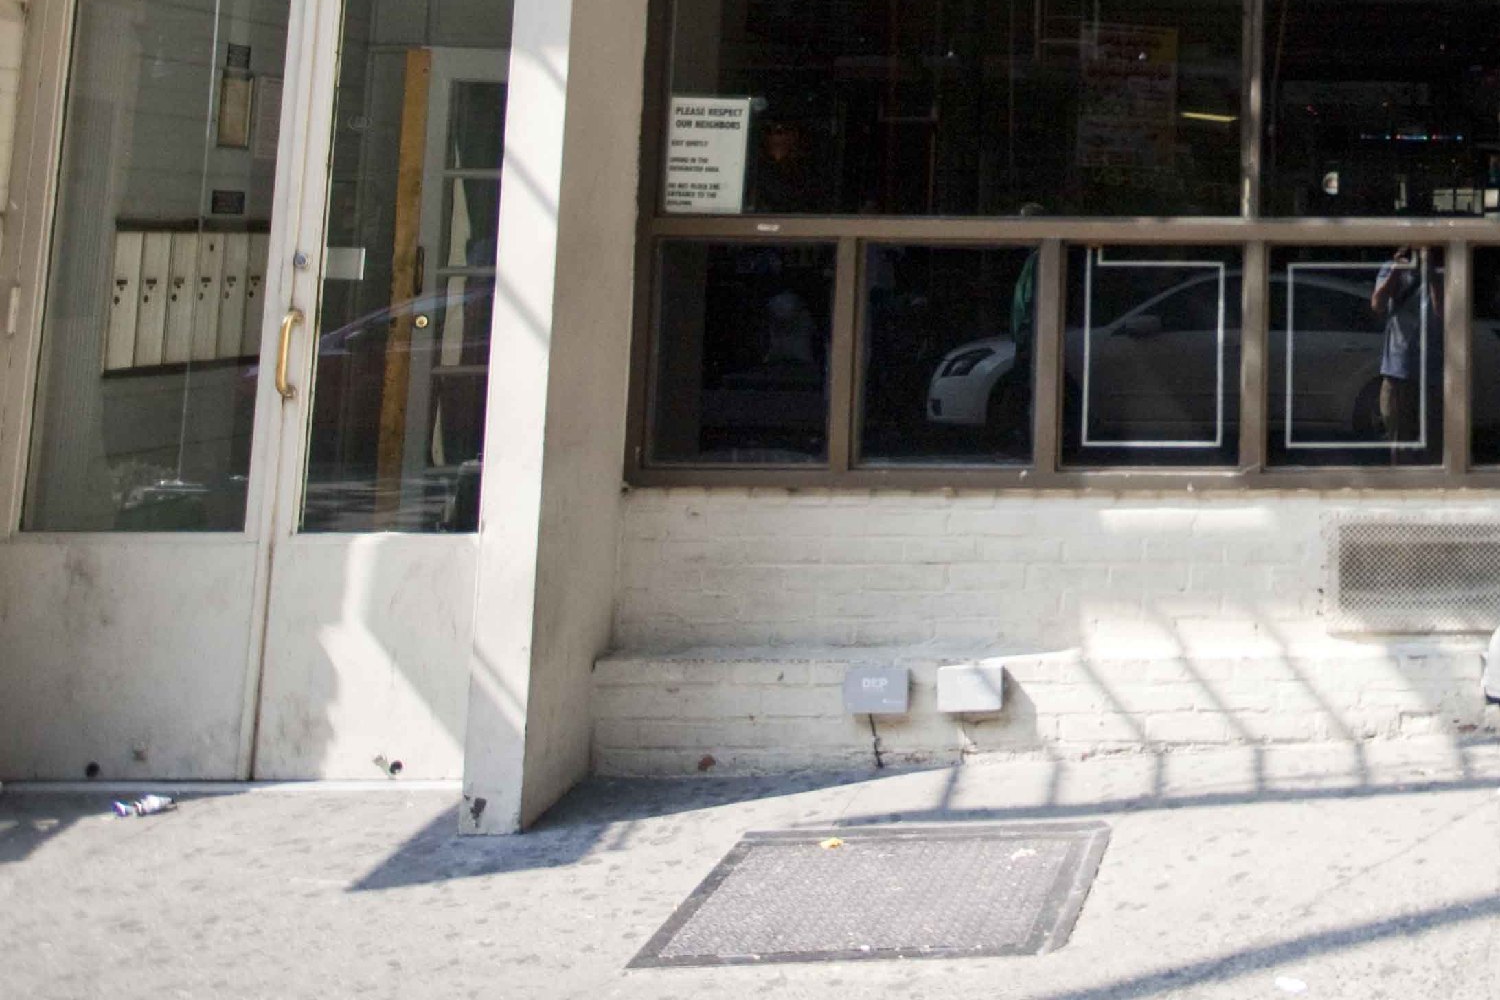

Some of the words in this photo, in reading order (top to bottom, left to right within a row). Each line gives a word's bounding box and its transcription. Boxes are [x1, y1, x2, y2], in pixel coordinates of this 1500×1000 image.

[675, 107, 706, 116] PLEASE
[708, 108, 743, 117] RESPECT
[675, 120, 693, 129] OUR
[695, 120, 741, 130] NEIGHBORS
[861, 677, 888, 689] DEP
